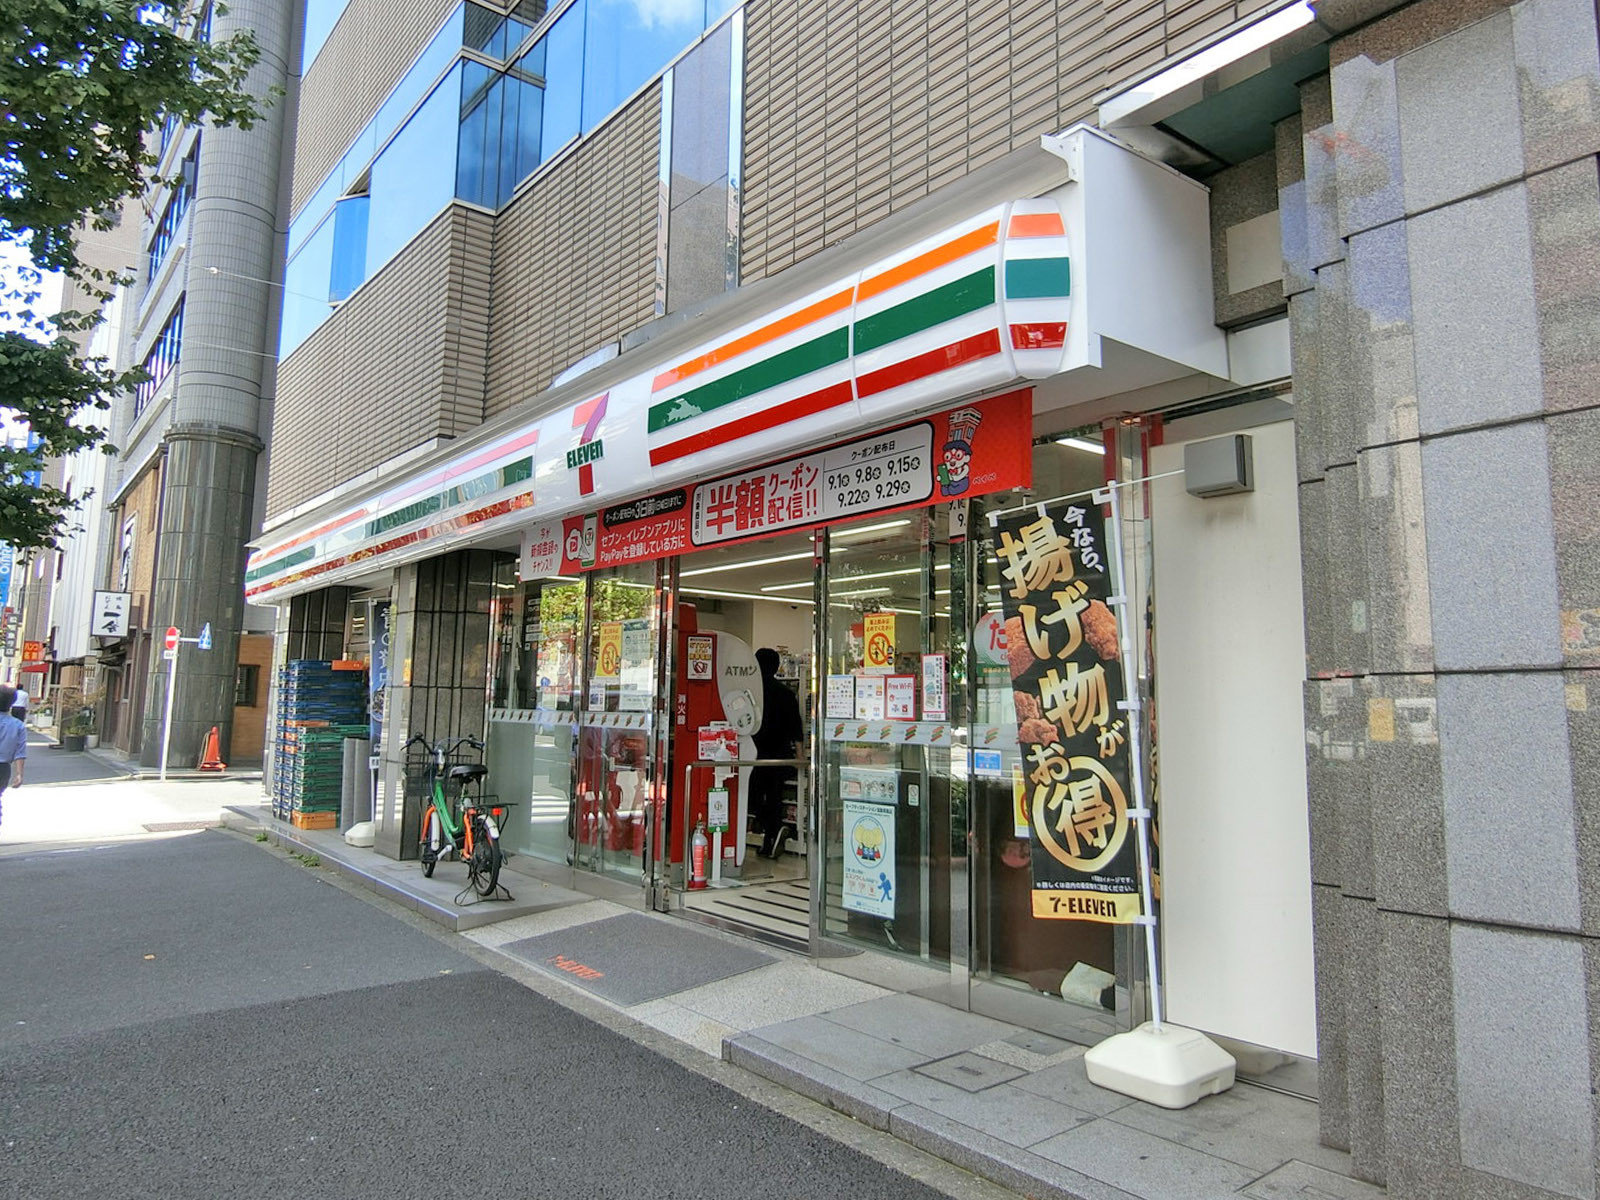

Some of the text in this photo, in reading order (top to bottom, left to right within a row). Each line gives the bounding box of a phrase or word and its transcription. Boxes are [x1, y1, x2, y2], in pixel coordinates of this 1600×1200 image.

[850, 440, 896, 461] クーポン配布日
[768, 462, 819, 496] クーポン
[706, 476, 766, 535] 半額
[600, 535, 687, 564] PayPayを登録している方に
